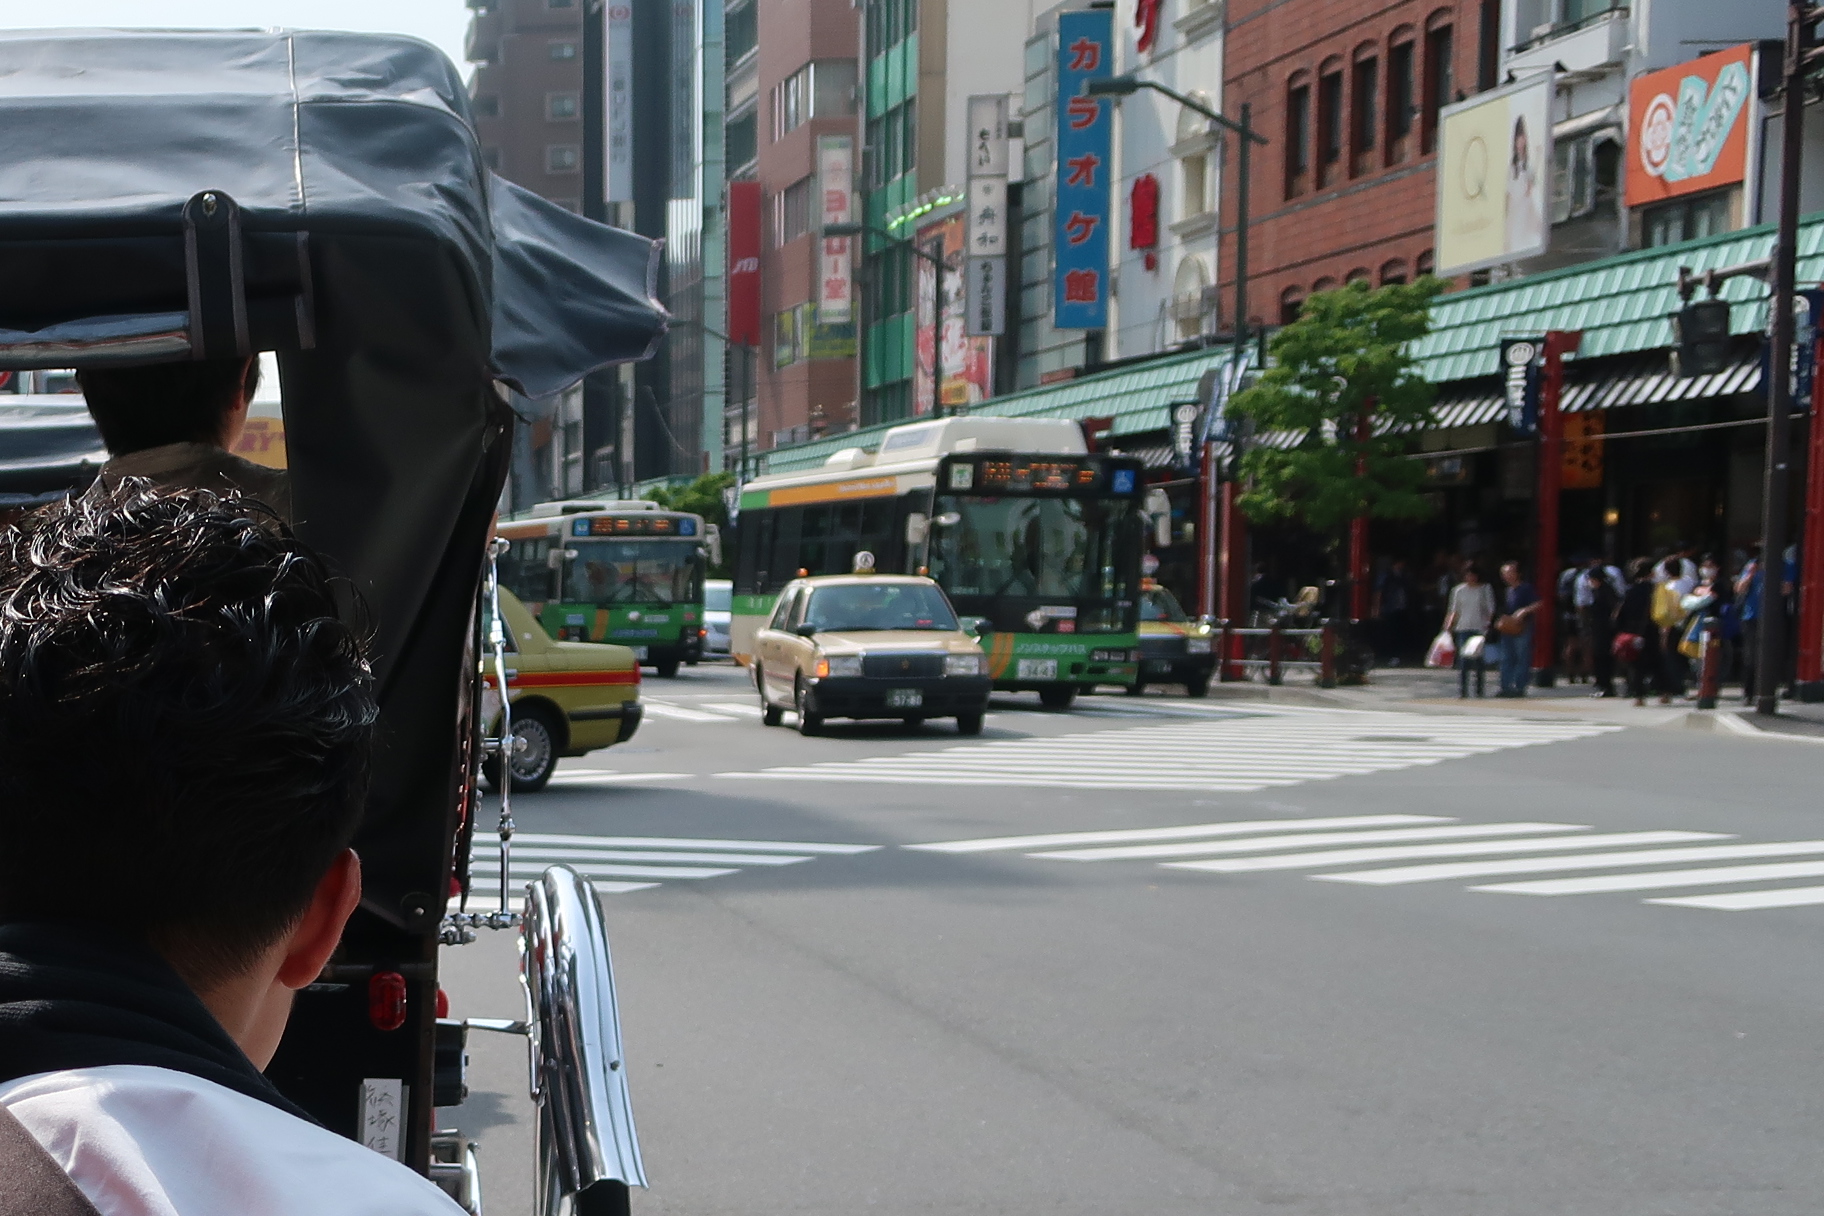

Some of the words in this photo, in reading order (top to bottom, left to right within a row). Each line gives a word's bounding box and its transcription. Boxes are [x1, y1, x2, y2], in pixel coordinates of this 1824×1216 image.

[1064, 38, 1101, 303] カラオケ館
[733, 257, 759, 274] JTB
